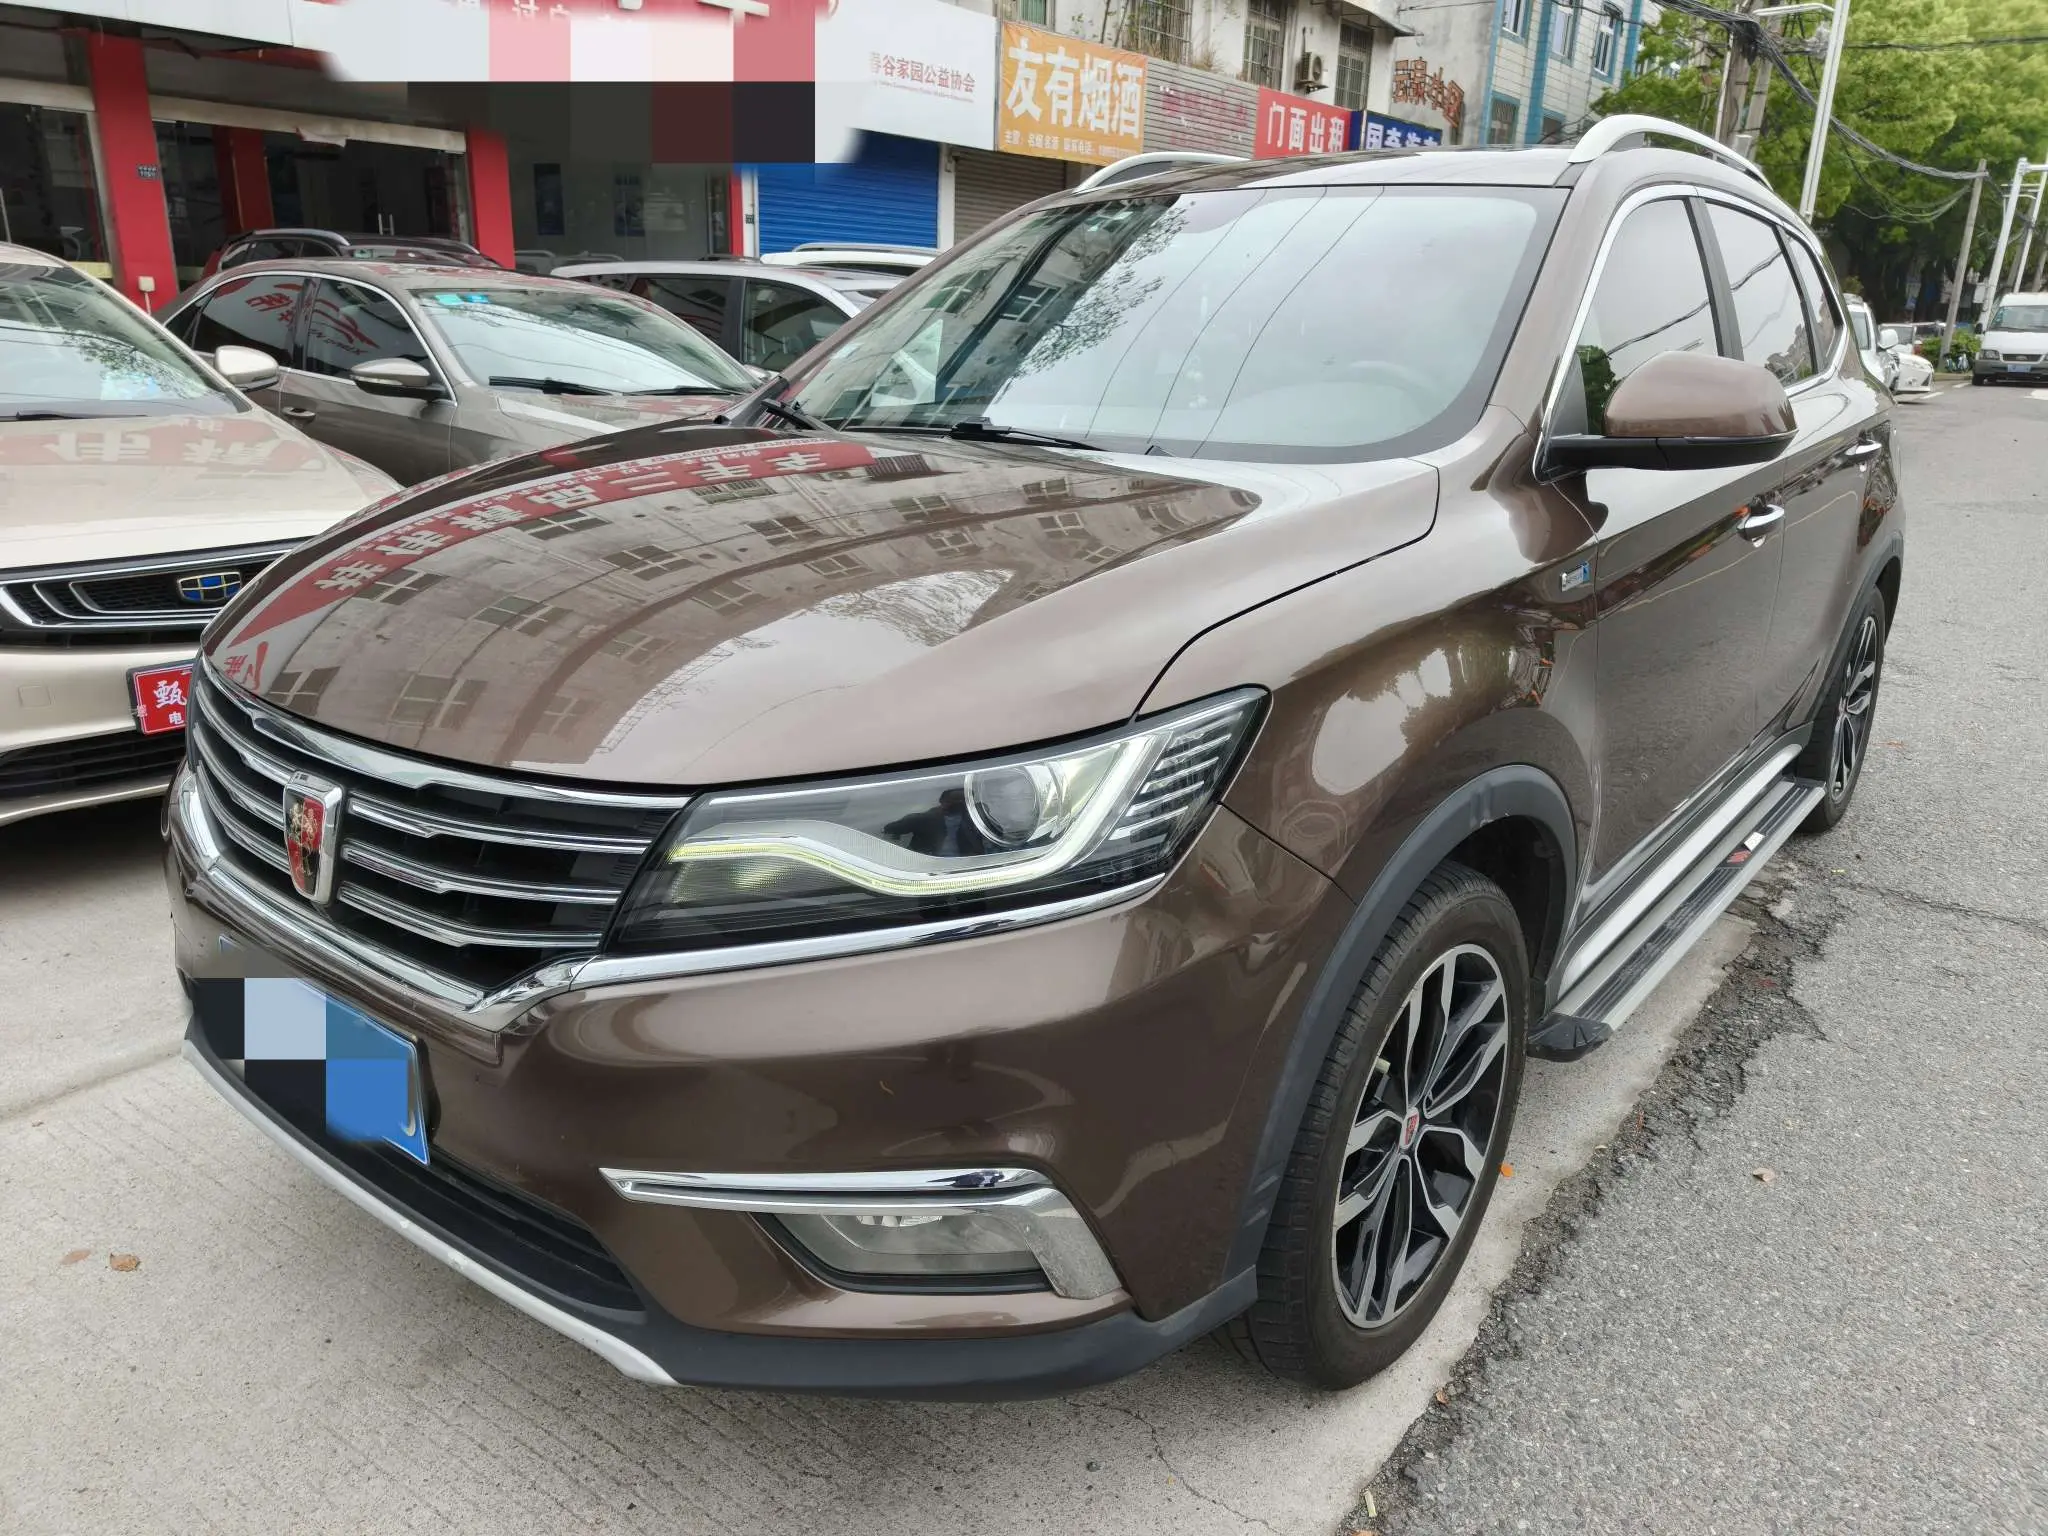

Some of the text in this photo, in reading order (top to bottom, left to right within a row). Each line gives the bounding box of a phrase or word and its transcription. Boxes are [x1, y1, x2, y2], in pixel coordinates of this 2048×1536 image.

[1006, 36, 1143, 139] 友有烟酒
[1267, 101, 1345, 153] 门面出租
[168, 711, 185, 725] 电
